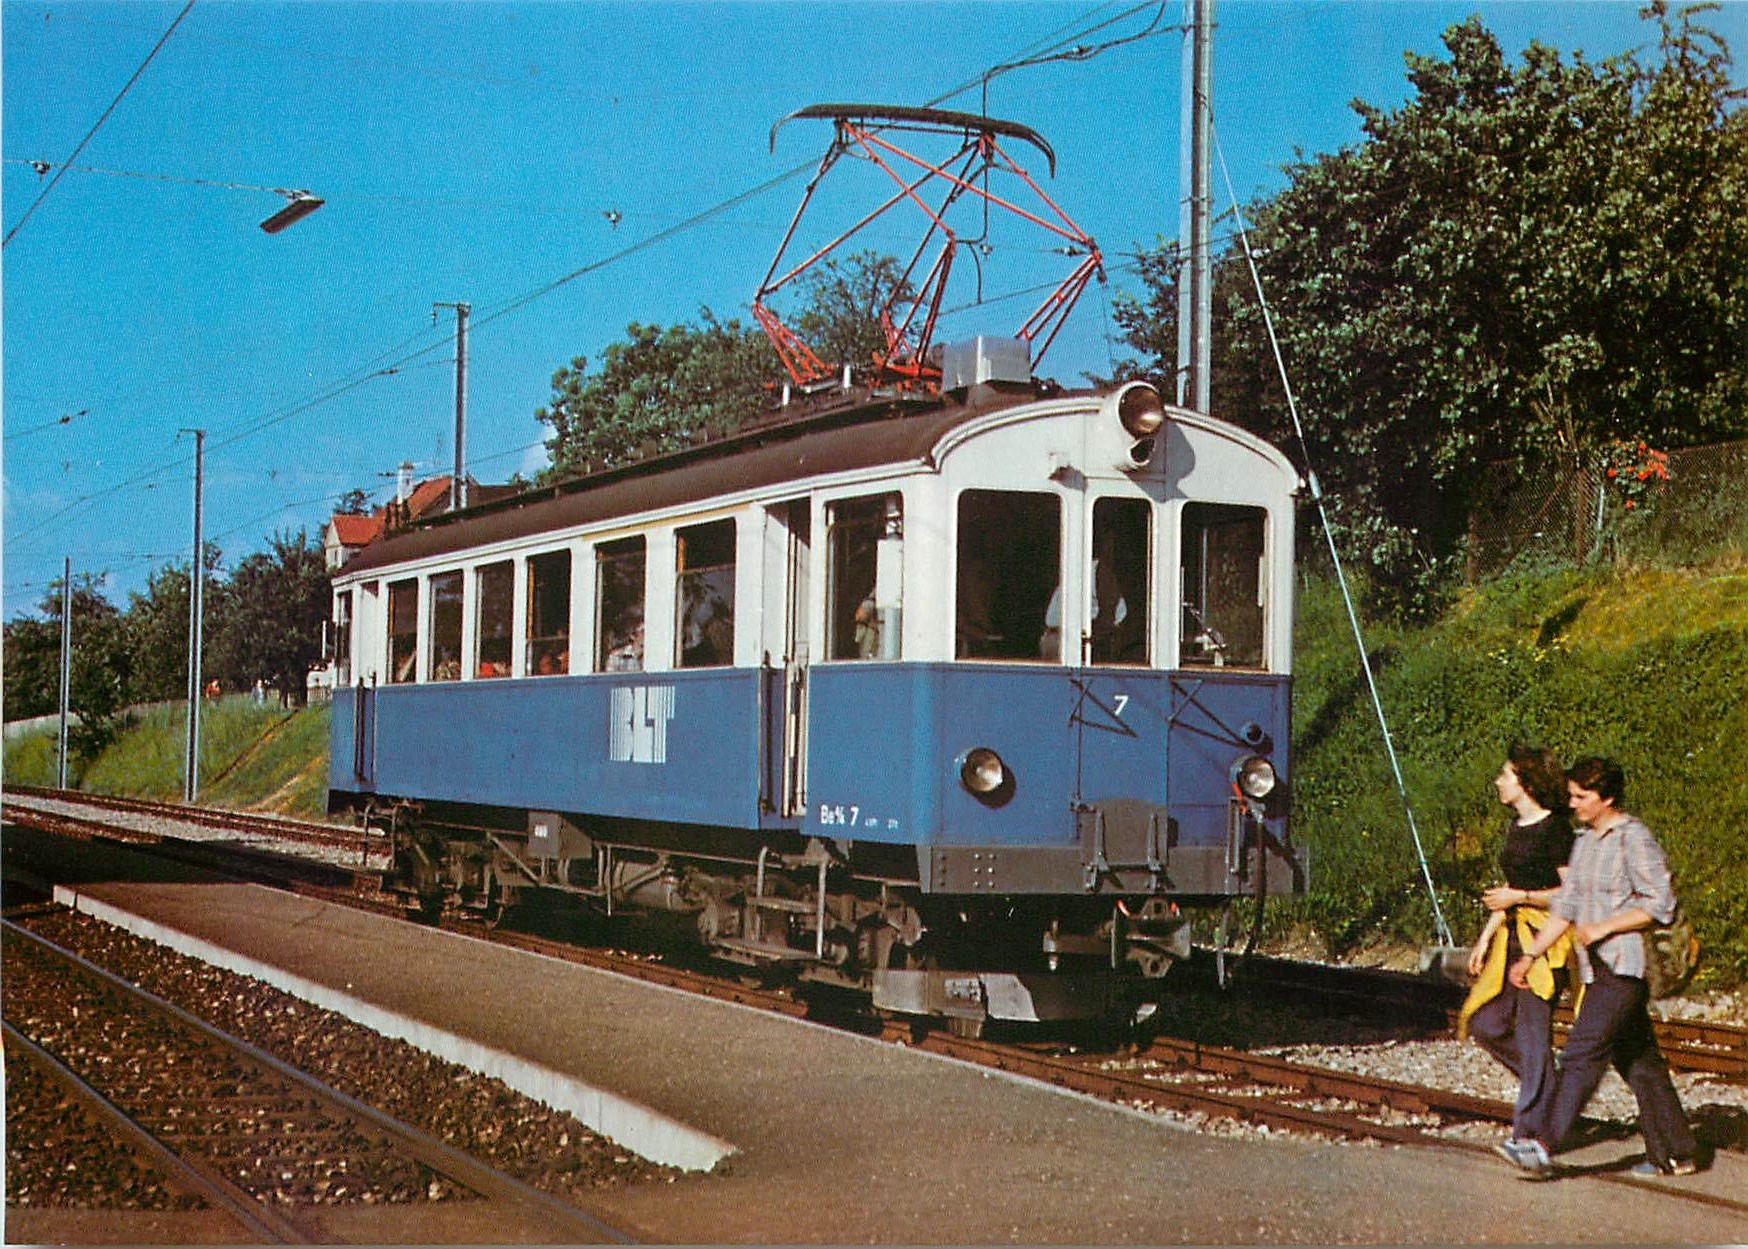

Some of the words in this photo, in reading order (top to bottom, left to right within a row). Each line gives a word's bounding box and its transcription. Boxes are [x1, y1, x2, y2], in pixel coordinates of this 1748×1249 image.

[1114, 694, 1129, 716] 7
[609, 685, 676, 764] BLT
[850, 806, 860, 827] 7
